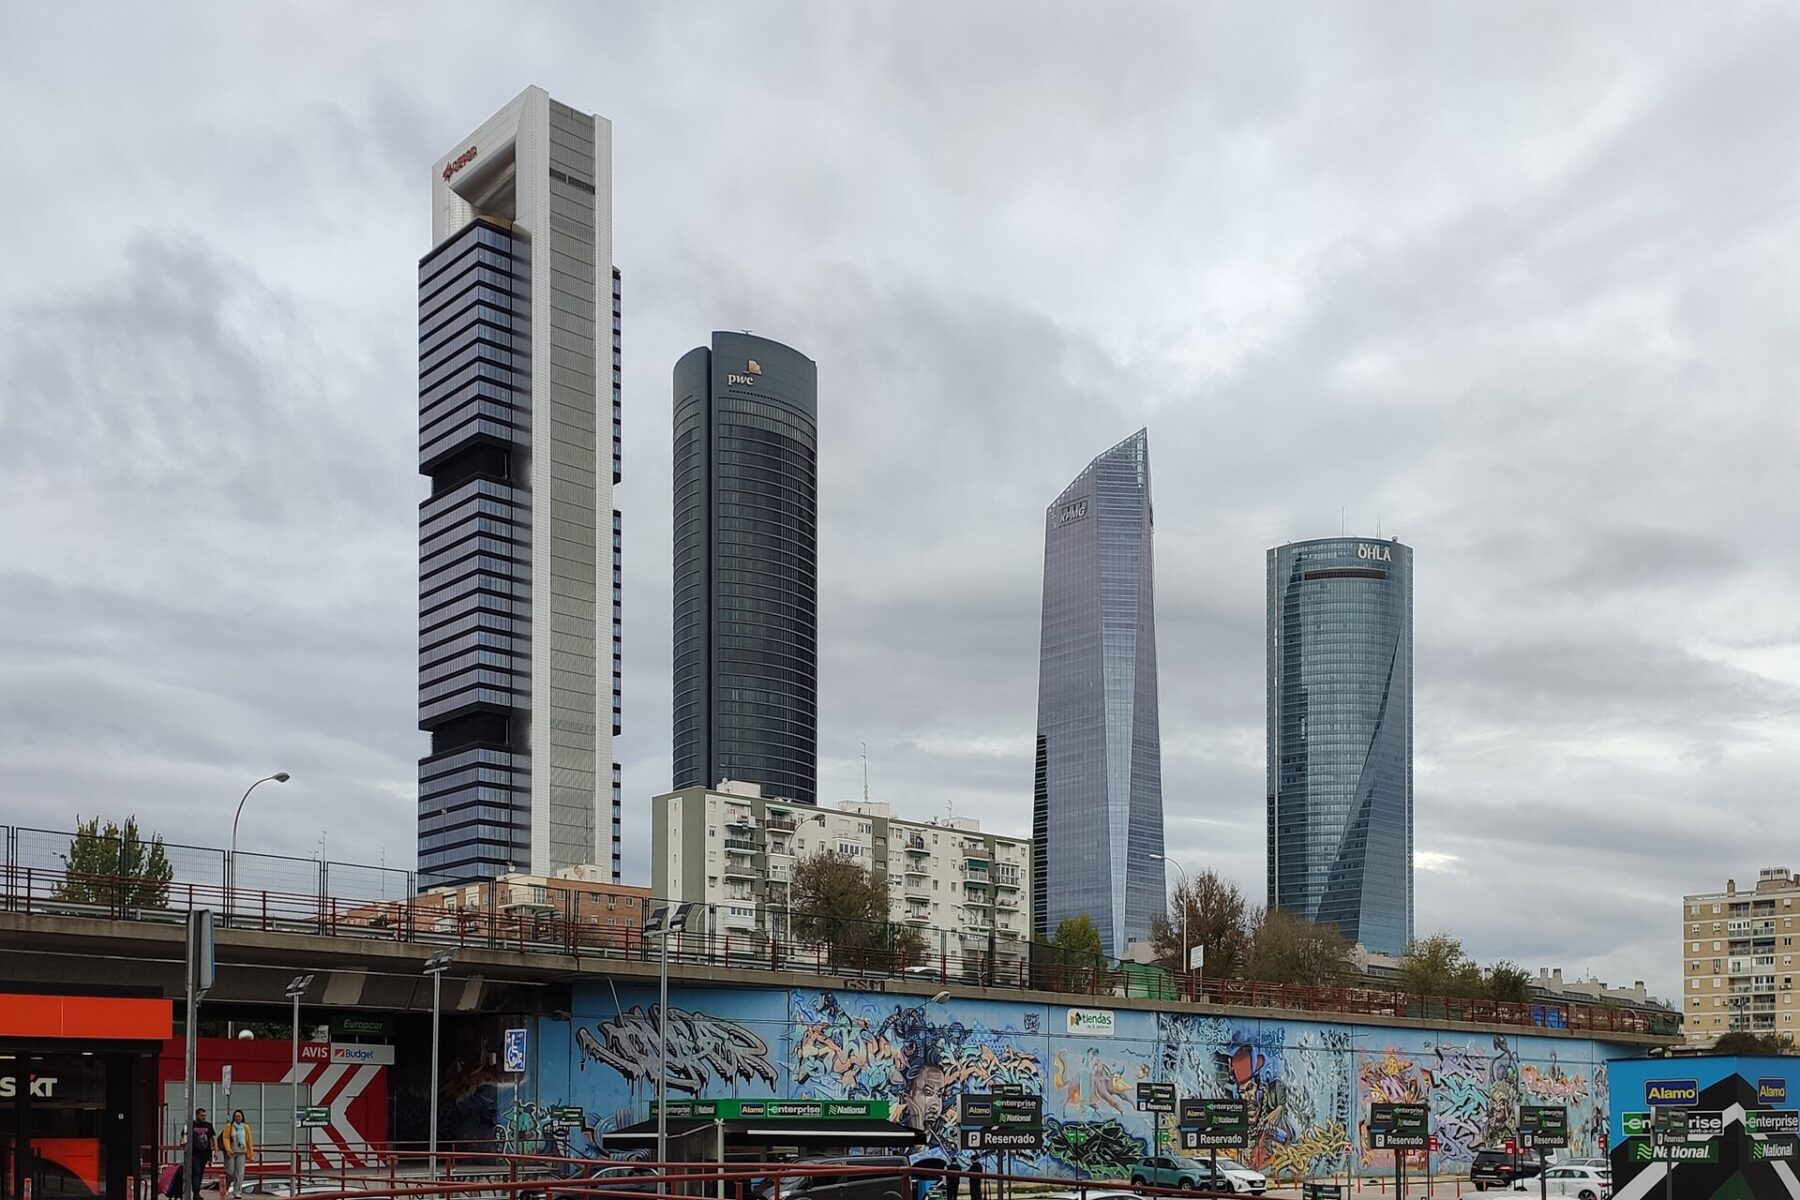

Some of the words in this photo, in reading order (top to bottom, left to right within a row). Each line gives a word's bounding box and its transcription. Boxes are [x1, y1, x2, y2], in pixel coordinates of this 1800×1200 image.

[727, 374, 754, 386] pwc
[1358, 545, 1391, 562] OHLA
[1082, 1012, 1112, 1025] tiendas
[343, 1019, 383, 1030] Europcar
[301, 1047, 328, 1058] AVIS
[345, 1048, 374, 1061] Budget
[1648, 1087, 1696, 1099] Alamo
[1760, 1085, 1785, 1097] Alamo
[837, 1105, 867, 1114] National
[996, 1100, 1036, 1108] enterprise
[1209, 1103, 1243, 1111] enterprise
[770, 1105, 821, 1115] enterprise
[1006, 1114, 1032, 1122] National
[1626, 1116, 1722, 1129] enrise
[1747, 1114, 1799, 1130] enterprise
[984, 1133, 1036, 1144] Reservado
[1200, 1134, 1243, 1144] Reservado
[1387, 1135, 1424, 1145] Reservado
[1533, 1136, 1565, 1145] Reservado
[1664, 1134, 1686, 1143] Reservado
[1762, 1143, 1793, 1158] National
